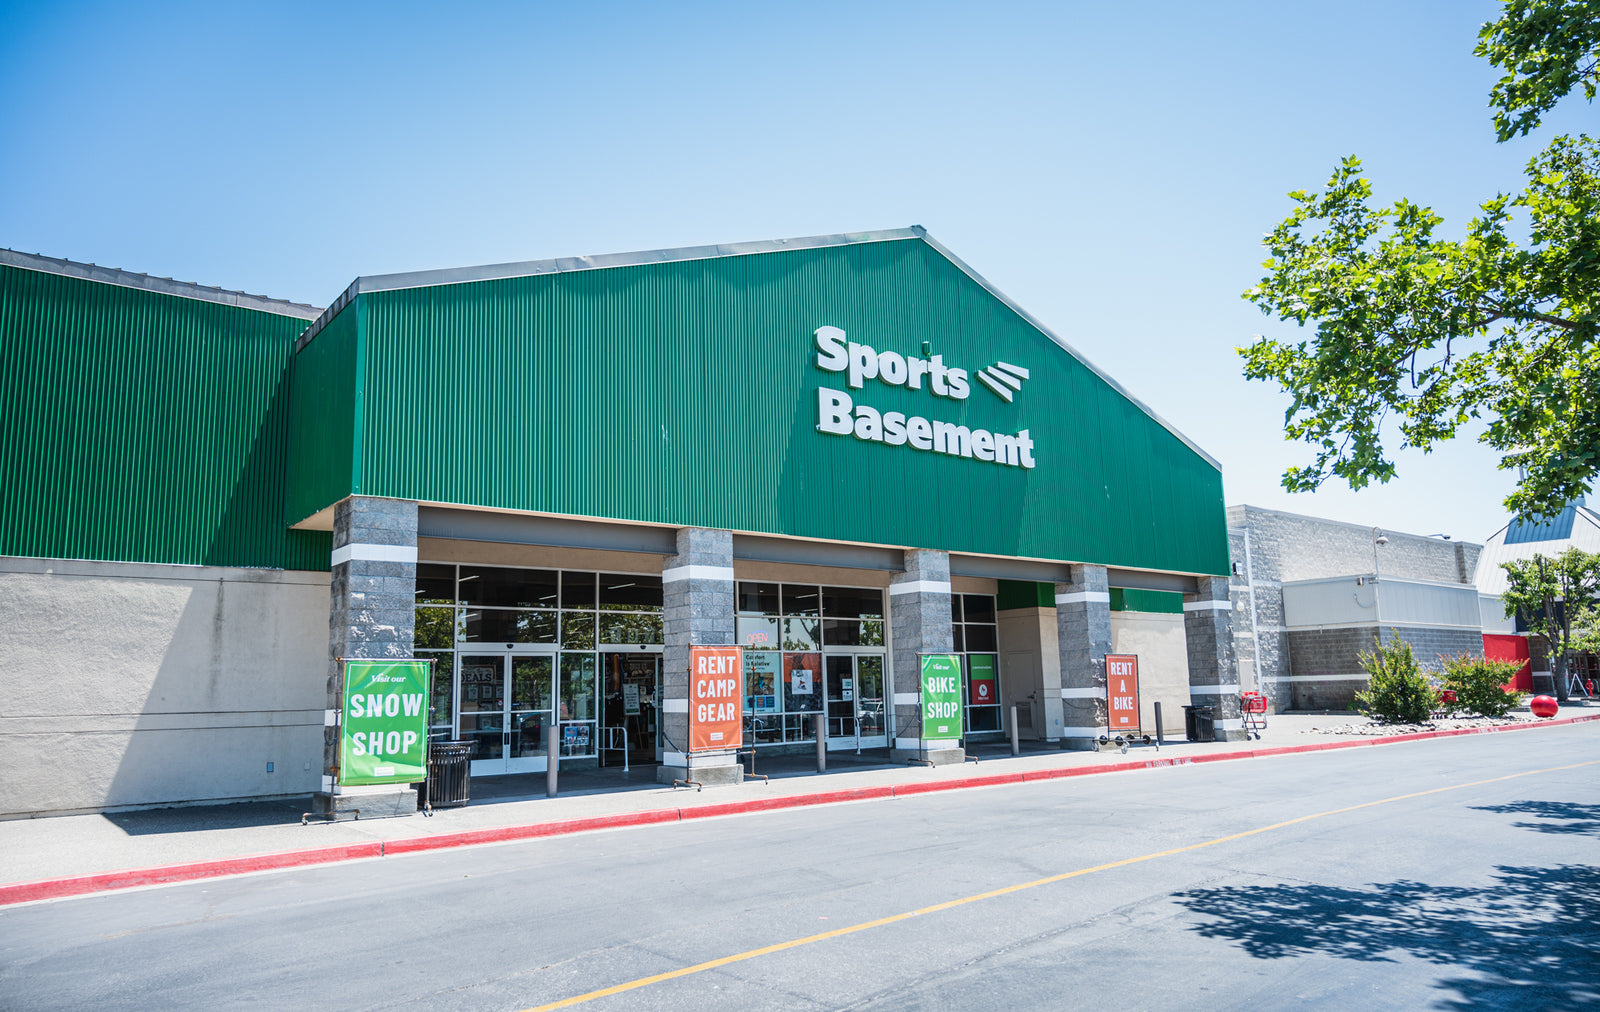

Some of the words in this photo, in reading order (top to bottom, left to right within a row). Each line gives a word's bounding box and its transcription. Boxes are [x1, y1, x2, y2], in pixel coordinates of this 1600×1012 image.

[814, 325, 970, 399] Sports
[816, 386, 1035, 468] Basement
[746, 632, 768, 643] OPEN
[698, 656, 736, 674] RENT
[1110, 662, 1133, 676] RENT
[371, 673, 390, 683] Visit
[928, 677, 956, 693] BIKE
[1120, 680, 1126, 693] A
[697, 679, 736, 698] CAMP
[350, 693, 423, 718] SNOW
[928, 702, 958, 719] SHOP
[1113, 697, 1134, 710] BIKE
[697, 703, 735, 723] GEAR
[352, 731, 417, 756] SHOP
